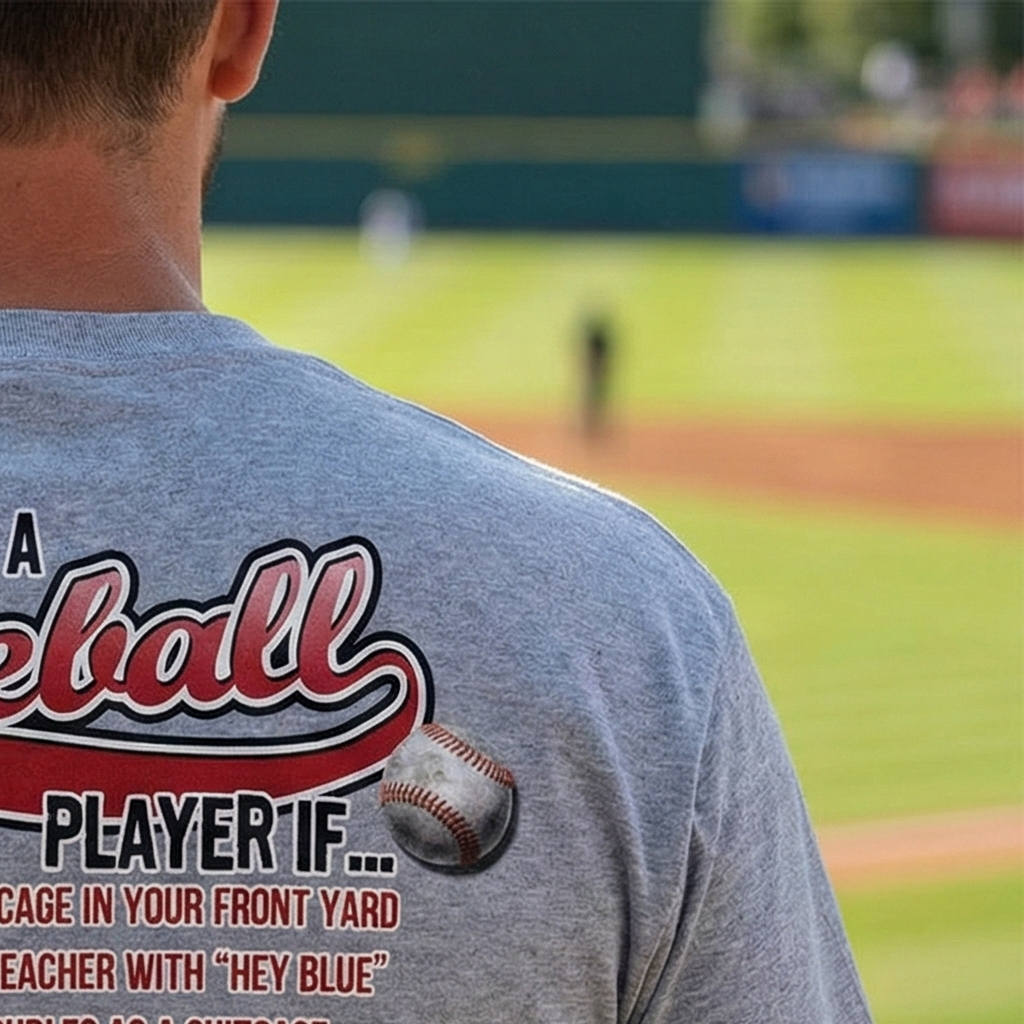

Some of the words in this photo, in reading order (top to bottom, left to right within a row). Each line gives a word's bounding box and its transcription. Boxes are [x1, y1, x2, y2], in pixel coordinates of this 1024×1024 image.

[5, 511, 43, 575] A
[44, 788, 280, 876] PLAYER
[295, 790, 400, 878] IF...
[82, 885, 114, 925] IN
[124, 886, 204, 926] YOUR
[213, 886, 310, 926] FRONT
[320, 889, 400, 930] YARD
[125, 952, 205, 991] WITH
[215, 953, 289, 992] “HEY
[298, 954, 388, 995] BLUE”
